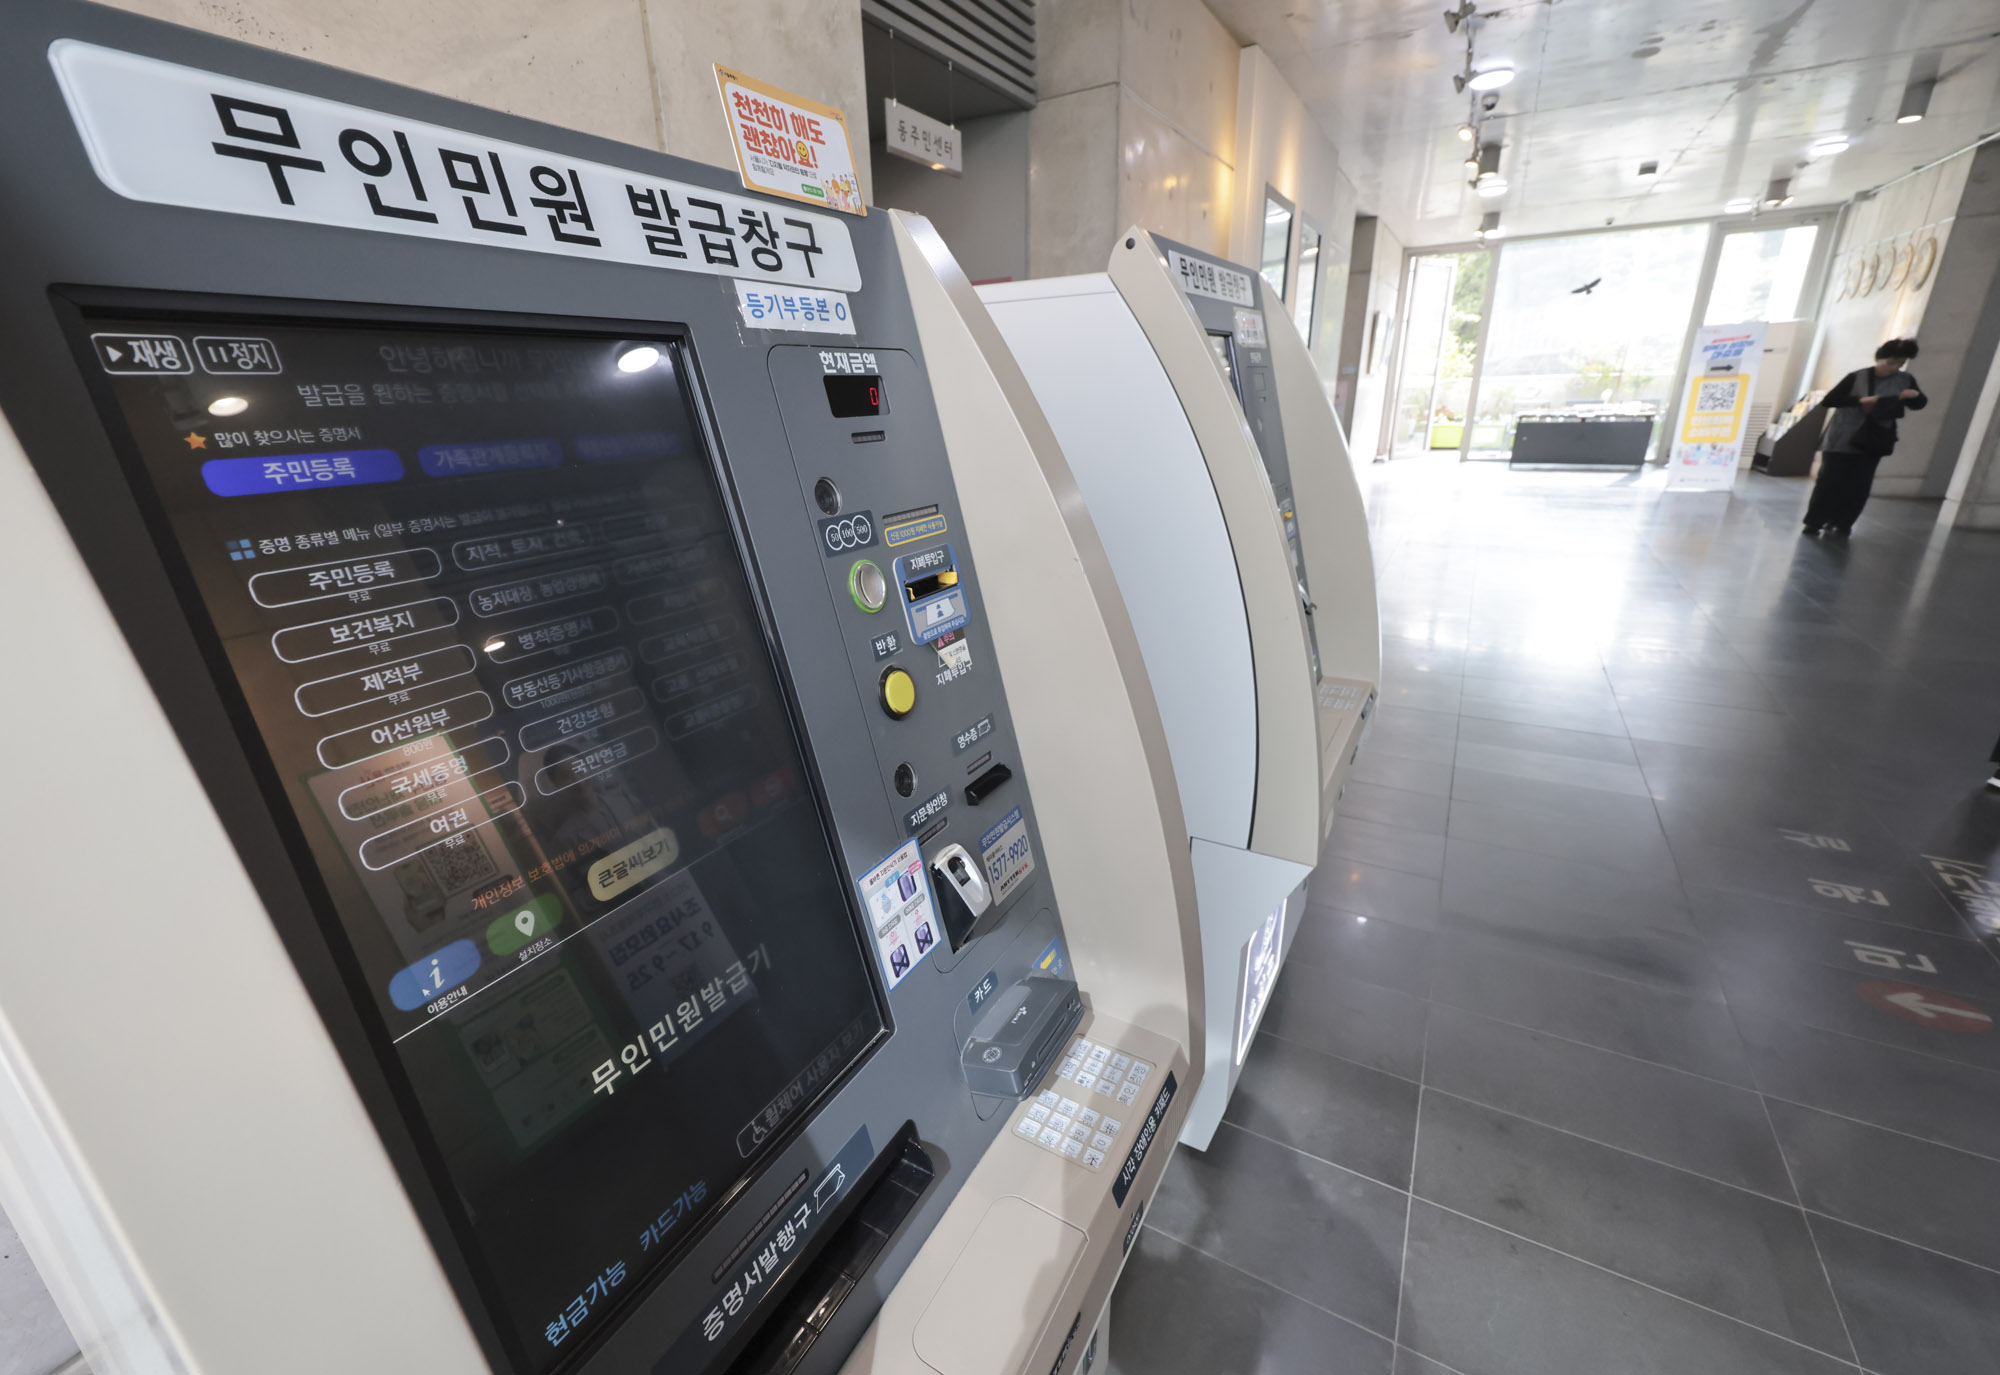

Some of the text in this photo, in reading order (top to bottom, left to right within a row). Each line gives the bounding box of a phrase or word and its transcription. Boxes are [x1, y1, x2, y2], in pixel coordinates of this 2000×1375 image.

[732, 91, 826, 145] 천천히 해도
[740, 123, 818, 169] 괜찮아요!
[210, 93, 825, 278] 무인민원 발급창구
[1180, 257, 1217, 293] 무인민원
[746, 293, 829, 321] 등기부등본
[127, 339, 183, 371] 재생
[231, 343, 274, 370] 정지
[819, 351, 878, 373] 현재금액
[297, 384, 366, 407] 발급을
[373, 382, 432, 406] 원하는
[869, 387, 879, 406] 0
[214, 426, 362, 448] 많이 찾으시는 증명서
[262, 457, 356, 484] 주민등록
[258, 536, 292, 555] 증명
[294, 530, 340, 550] 종류별
[343, 525, 370, 542] 메뉴
[373, 520, 406, 540] (일부
[407, 514, 457, 534] 증명서는
[830, 522, 868, 542] 50 100 500
[909, 549, 945, 570] 지폐투입구
[308, 561, 396, 591] 주민등록
[347, 589, 372, 605] 무료
[329, 611, 415, 645] 보건복지
[517, 618, 594, 650] 병적증명서
[368, 641, 392, 657] 무료
[875, 634, 897, 656] 반환
[361, 662, 424, 694] 제적부
[936, 660, 973, 686] 지폐투입구
[387, 690, 411, 706] 무료
[370, 708, 451, 747] 어선원부
[557, 702, 616, 735] 건강보험
[957, 727, 978, 749] 영수증
[570, 742, 629, 777] 국민연금
[391, 756, 468, 796] 국세증명
[430, 807, 469, 838] 여권
[911, 792, 949, 827] 지문확인창
[443, 832, 466, 851] 무료
[598, 837, 671, 889] 큰글씨보기
[988, 835, 1029, 885] 1577-9920
[472, 875, 526, 911] 개인정보
[527, 853, 577, 885] 보호법에
[518, 937, 553, 962] 설치장소
[426, 985, 469, 1016] 이용안내
[974, 977, 993, 1004] 카드
[593, 943, 772, 1096] 무인민원발급기
[765, 1080, 805, 1128] 휠체어
[1122, 1086, 1171, 1185] 시각 장애인용 키패드
[639, 1179, 709, 1252] 카드가능
[702, 1203, 811, 1342] 증명서발행구
[544, 1260, 628, 1348] 현금가능
